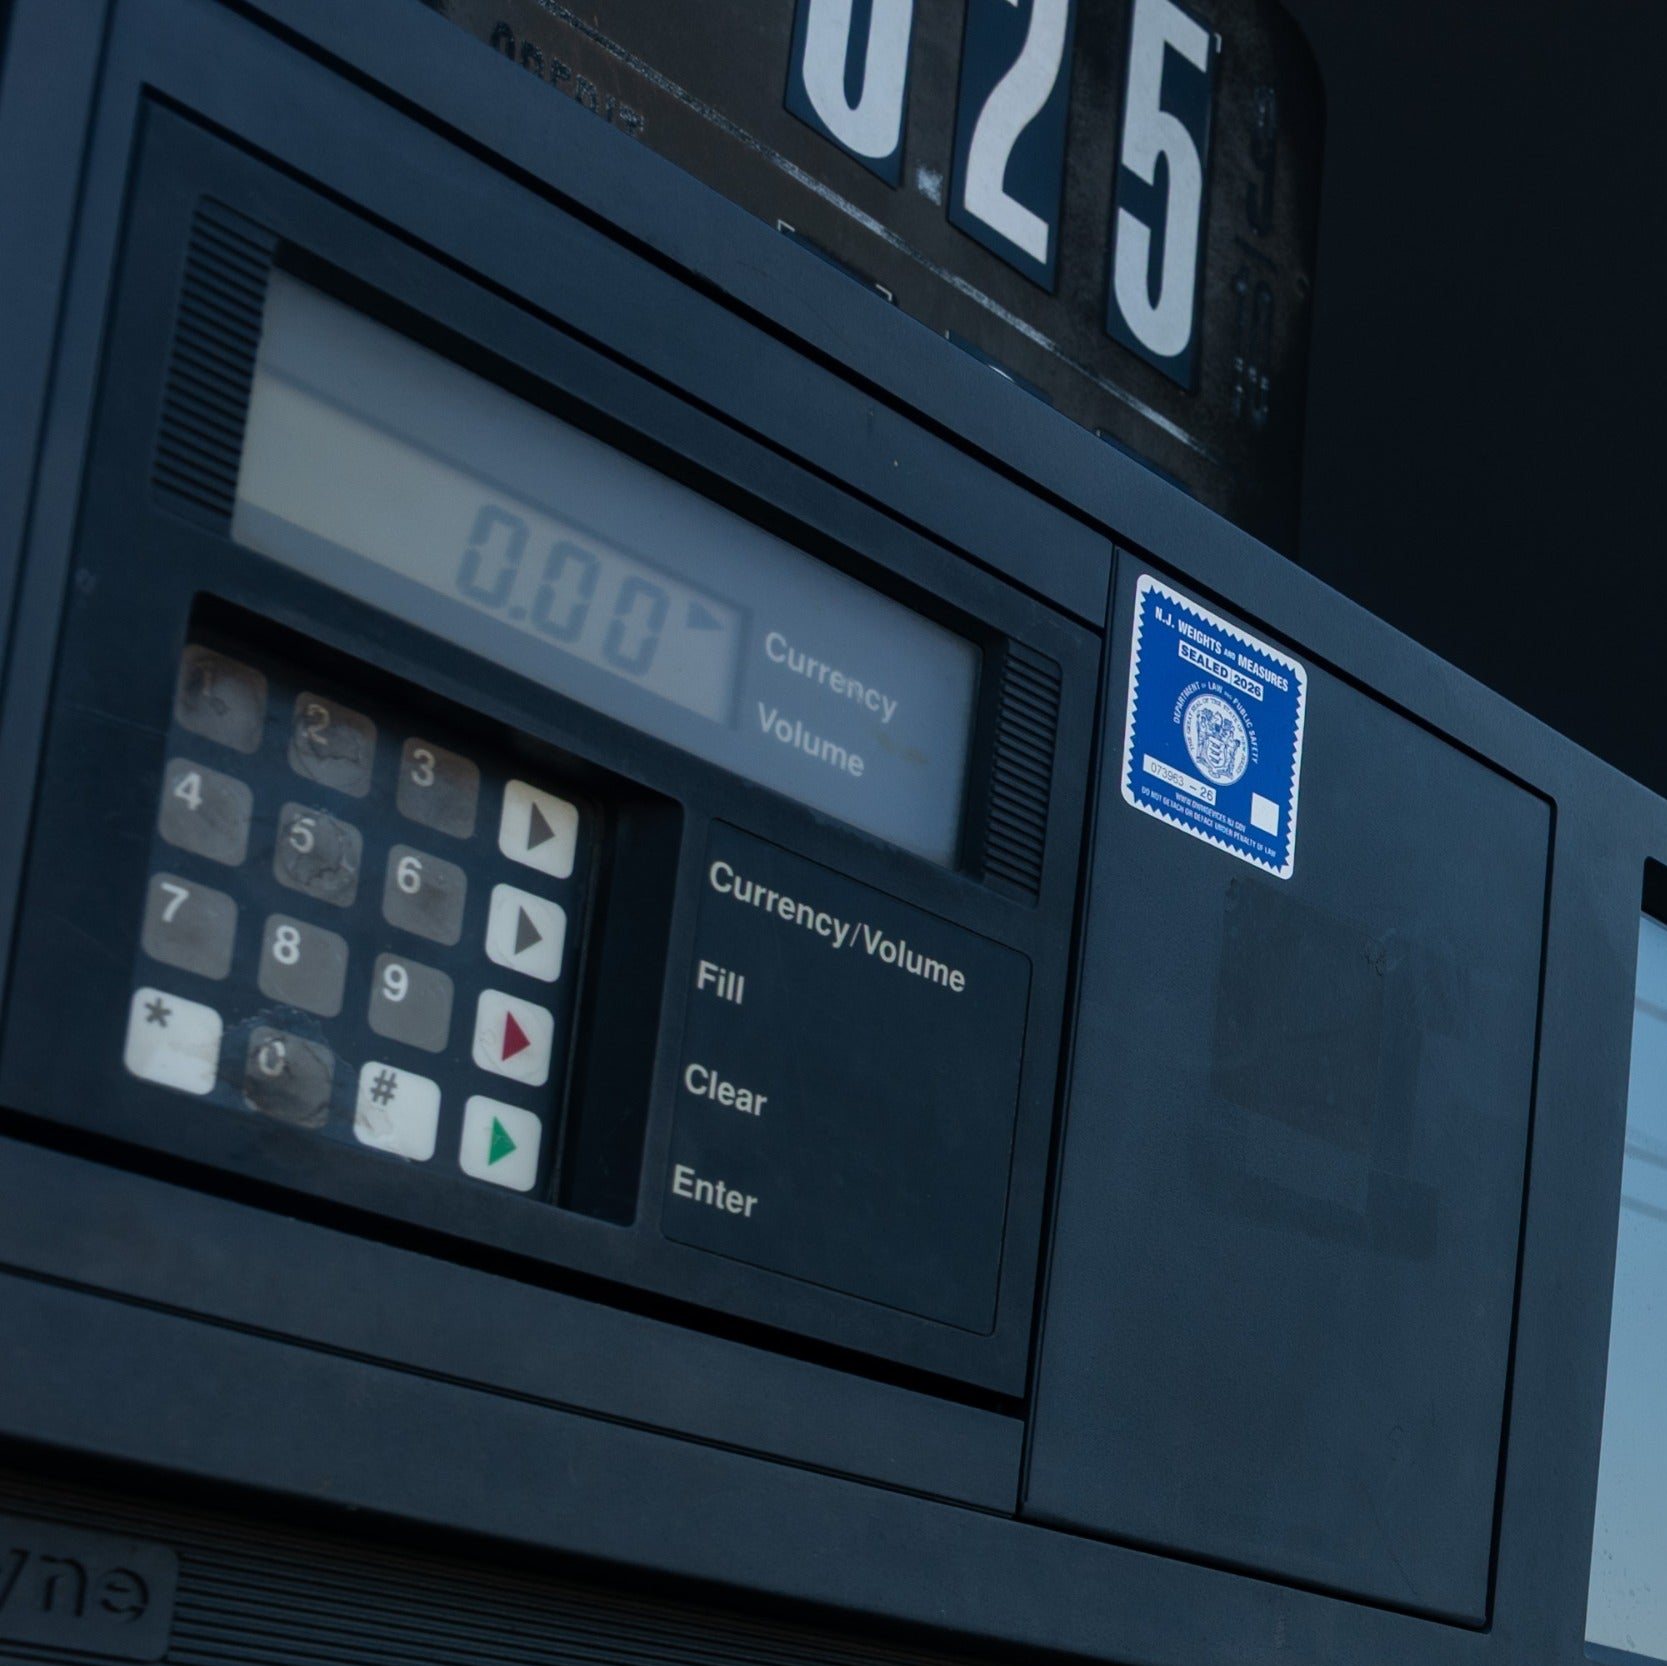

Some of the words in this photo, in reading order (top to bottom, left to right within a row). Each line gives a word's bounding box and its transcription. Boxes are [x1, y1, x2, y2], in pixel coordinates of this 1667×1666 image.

[456, 503, 670, 676] 0.00
[765, 631, 898, 724] Currency
[1155, 606, 1175, 629] N.J.
[1178, 619, 1222, 655] WEIGHTS
[1237, 654, 1288, 692] MEASURES
[1180, 644, 1229, 679] SEALED
[1233, 674, 1261, 698] 2026
[300, 705, 330, 745] 2
[411, 749, 436, 787] 3
[758, 702, 865, 778] Volume
[1173, 681, 1200, 725] DEPARTMENT
[1207, 681, 1223, 694] LAW
[1233, 698, 1253, 729] PUBLIC
[1249, 730, 1259, 765] SAFETY
[174, 772, 202, 810] 4
[290, 819, 314, 853] 5
[397, 857, 422, 893] 6
[1141, 785, 1151, 797] DO
[1151, 790, 1162, 803] NOT
[1162, 796, 1185, 815] DETACH
[1184, 806, 1194, 819] OR
[1193, 811, 1214, 829] DEFACE
[1214, 822, 1234, 839] UNDER
[1233, 832, 1257, 849] PENALTY
[1264, 847, 1277, 859] LAW
[1200, 785, 1214, 802] 26
[160, 884, 189, 922] 7
[273, 926, 300, 964] 8
[384, 966, 409, 1001] 9
[709, 860, 966, 993] Currency/Volume
[697, 960, 745, 1004] Fill
[685, 1064, 768, 1116] Clear
[672, 1164, 758, 1218] Enter
